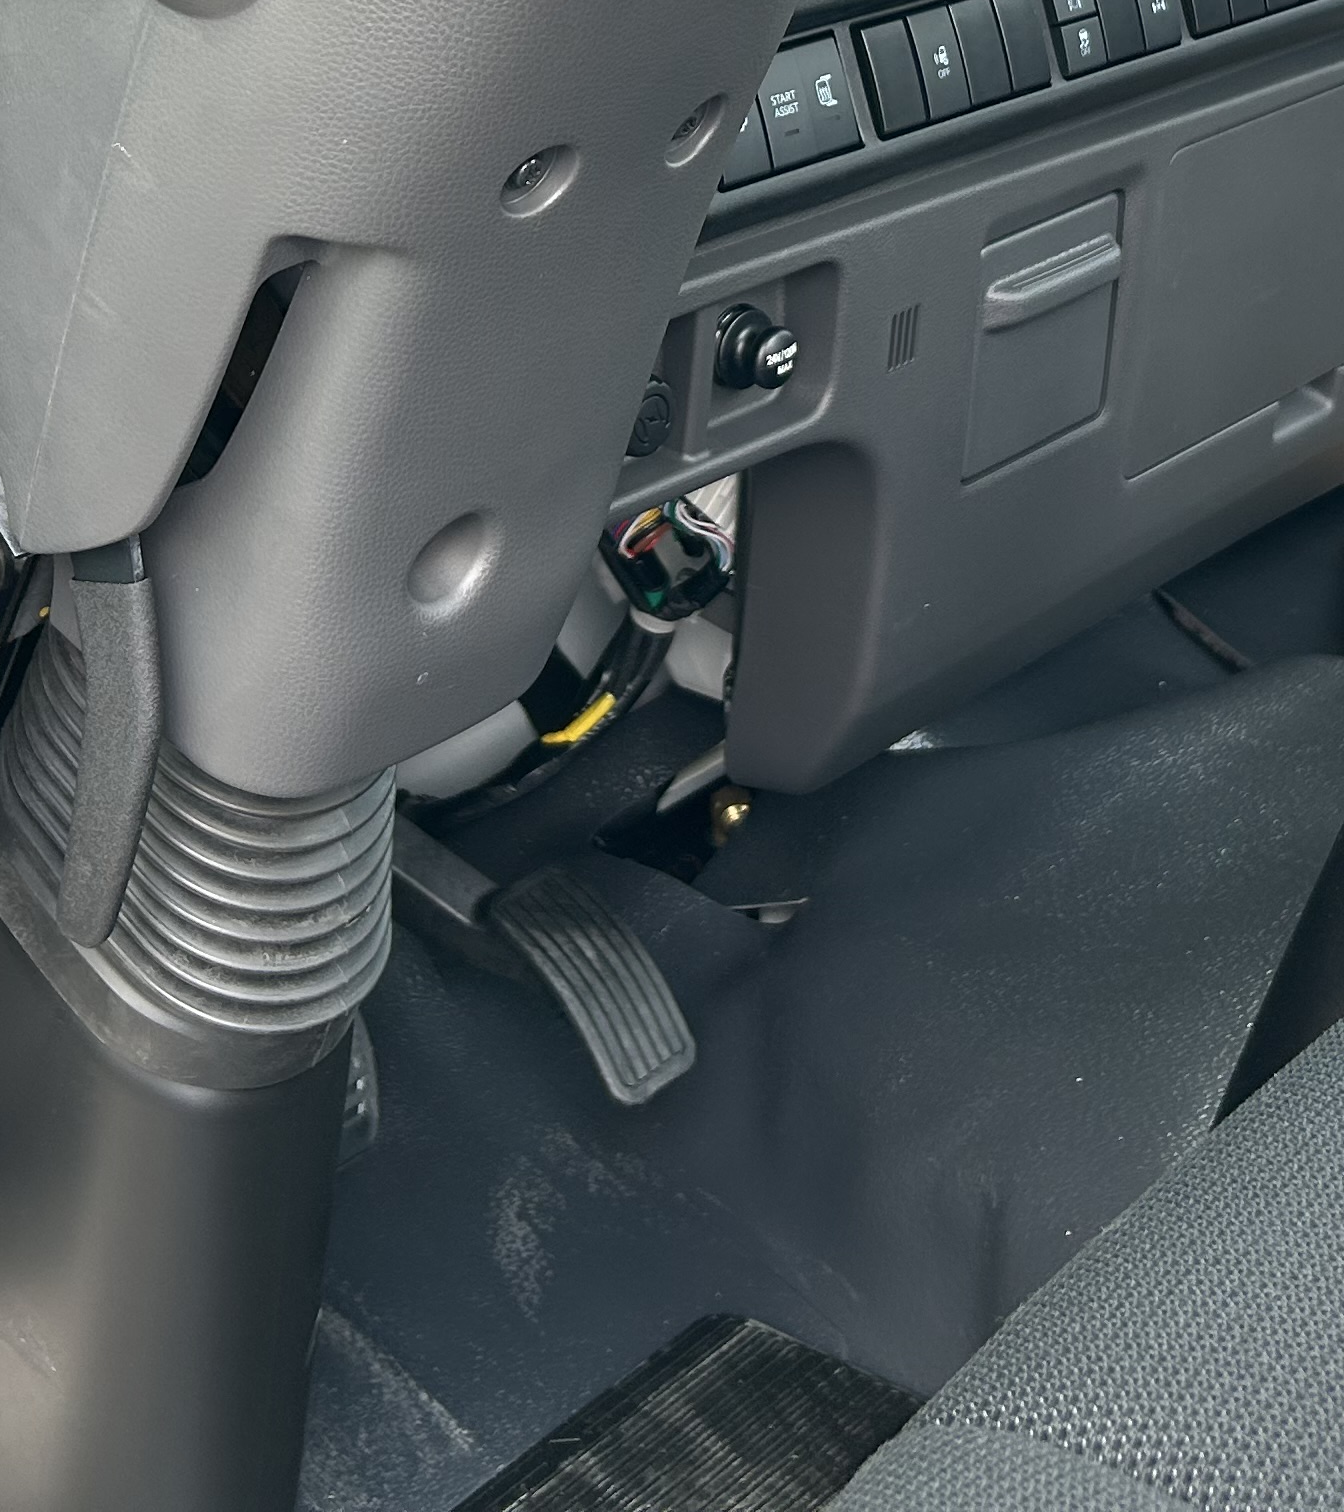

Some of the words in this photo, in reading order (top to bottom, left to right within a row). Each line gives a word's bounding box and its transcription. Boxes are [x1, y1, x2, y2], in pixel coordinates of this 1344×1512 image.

[937, 67, 951, 79] OFF
[770, 89, 796, 106] START
[774, 101, 799, 119] ASSIST
